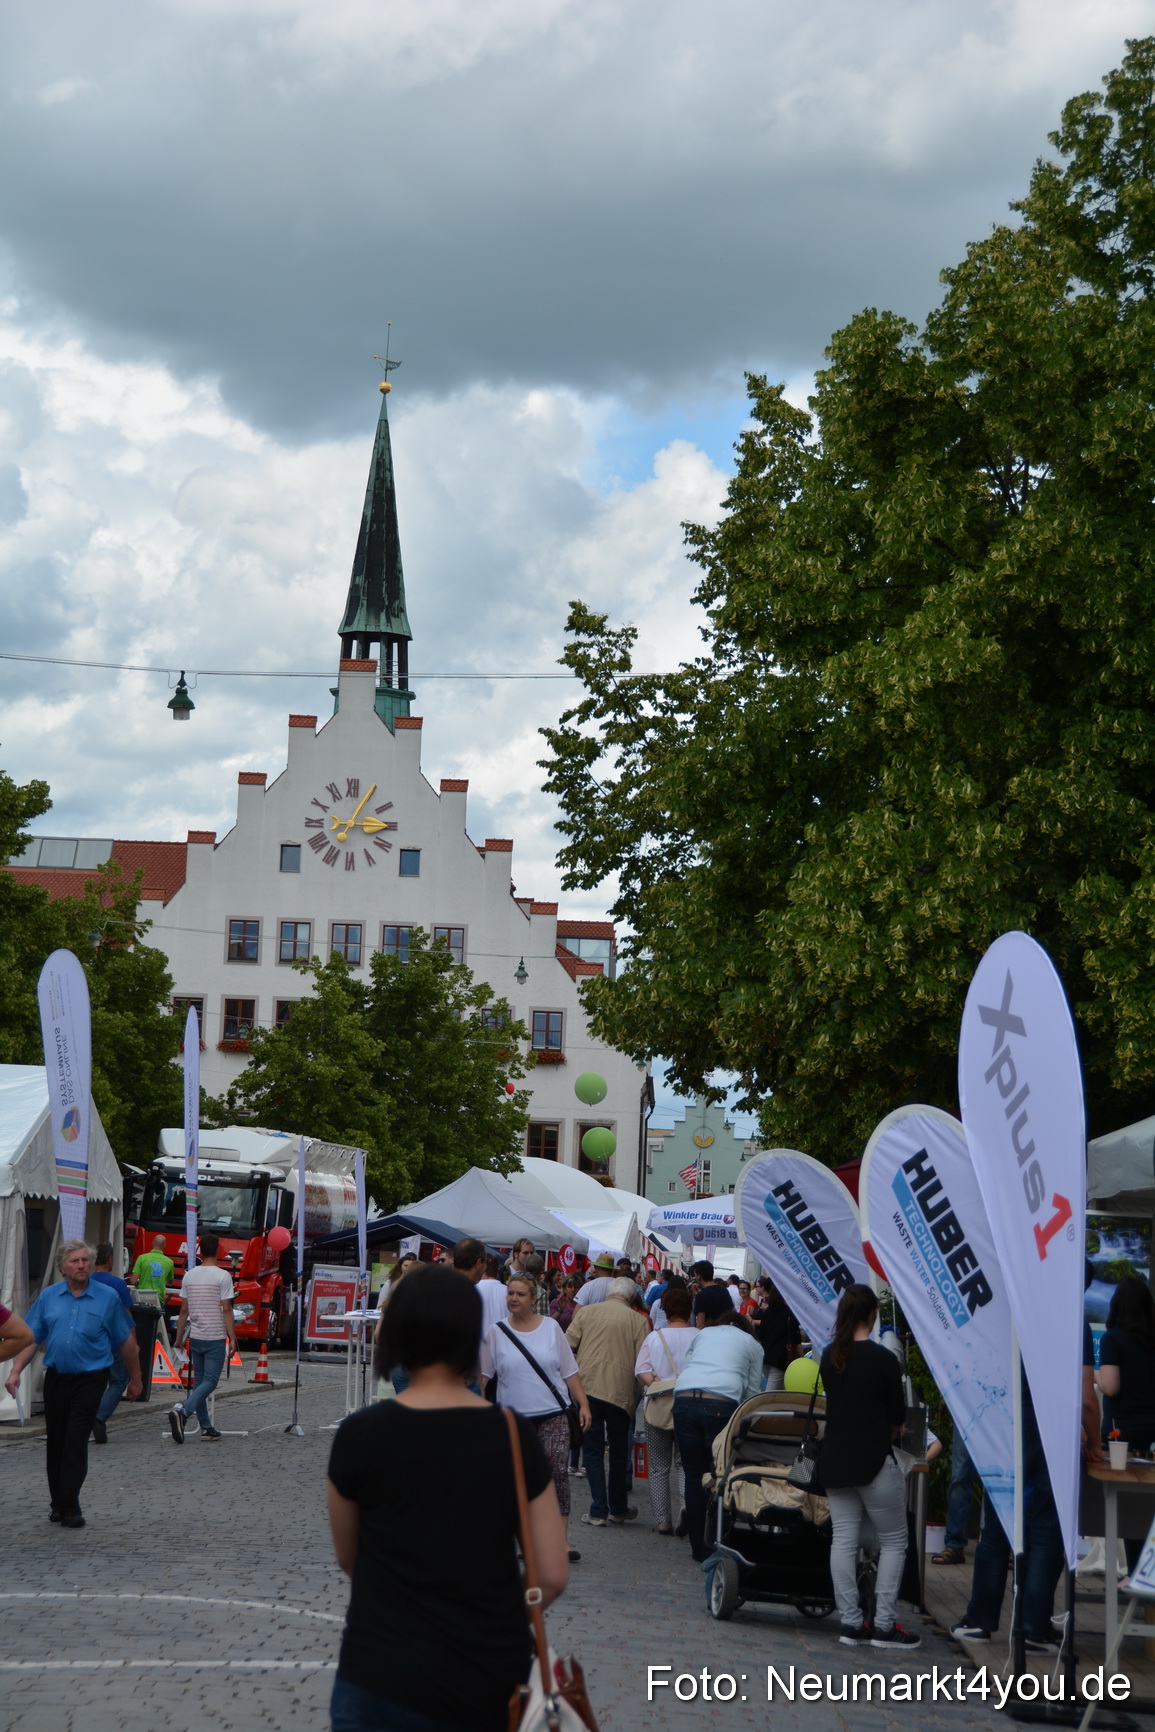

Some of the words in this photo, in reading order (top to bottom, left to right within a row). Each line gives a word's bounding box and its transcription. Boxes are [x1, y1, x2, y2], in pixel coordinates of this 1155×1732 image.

[179, 1173, 214, 1182] RDL
[663, 1211, 699, 1220] Winkler
[701, 1212, 723, 1220] Bräu
[765, 1222, 785, 1249] WASTE
[781, 1249, 801, 1275] WATER
[798, 1274, 820, 1304] Solutions
[772, 1179, 856, 1296] HUBER
[774, 1214, 832, 1299] TECHNOLOGY
[892, 1211, 913, 1249] WASTE
[909, 1249, 930, 1287] WATER
[927, 1286, 950, 1330] Solutions
[902, 1147, 993, 1317] HUBER
[904, 1199, 966, 1319] TECHNOLOGY
